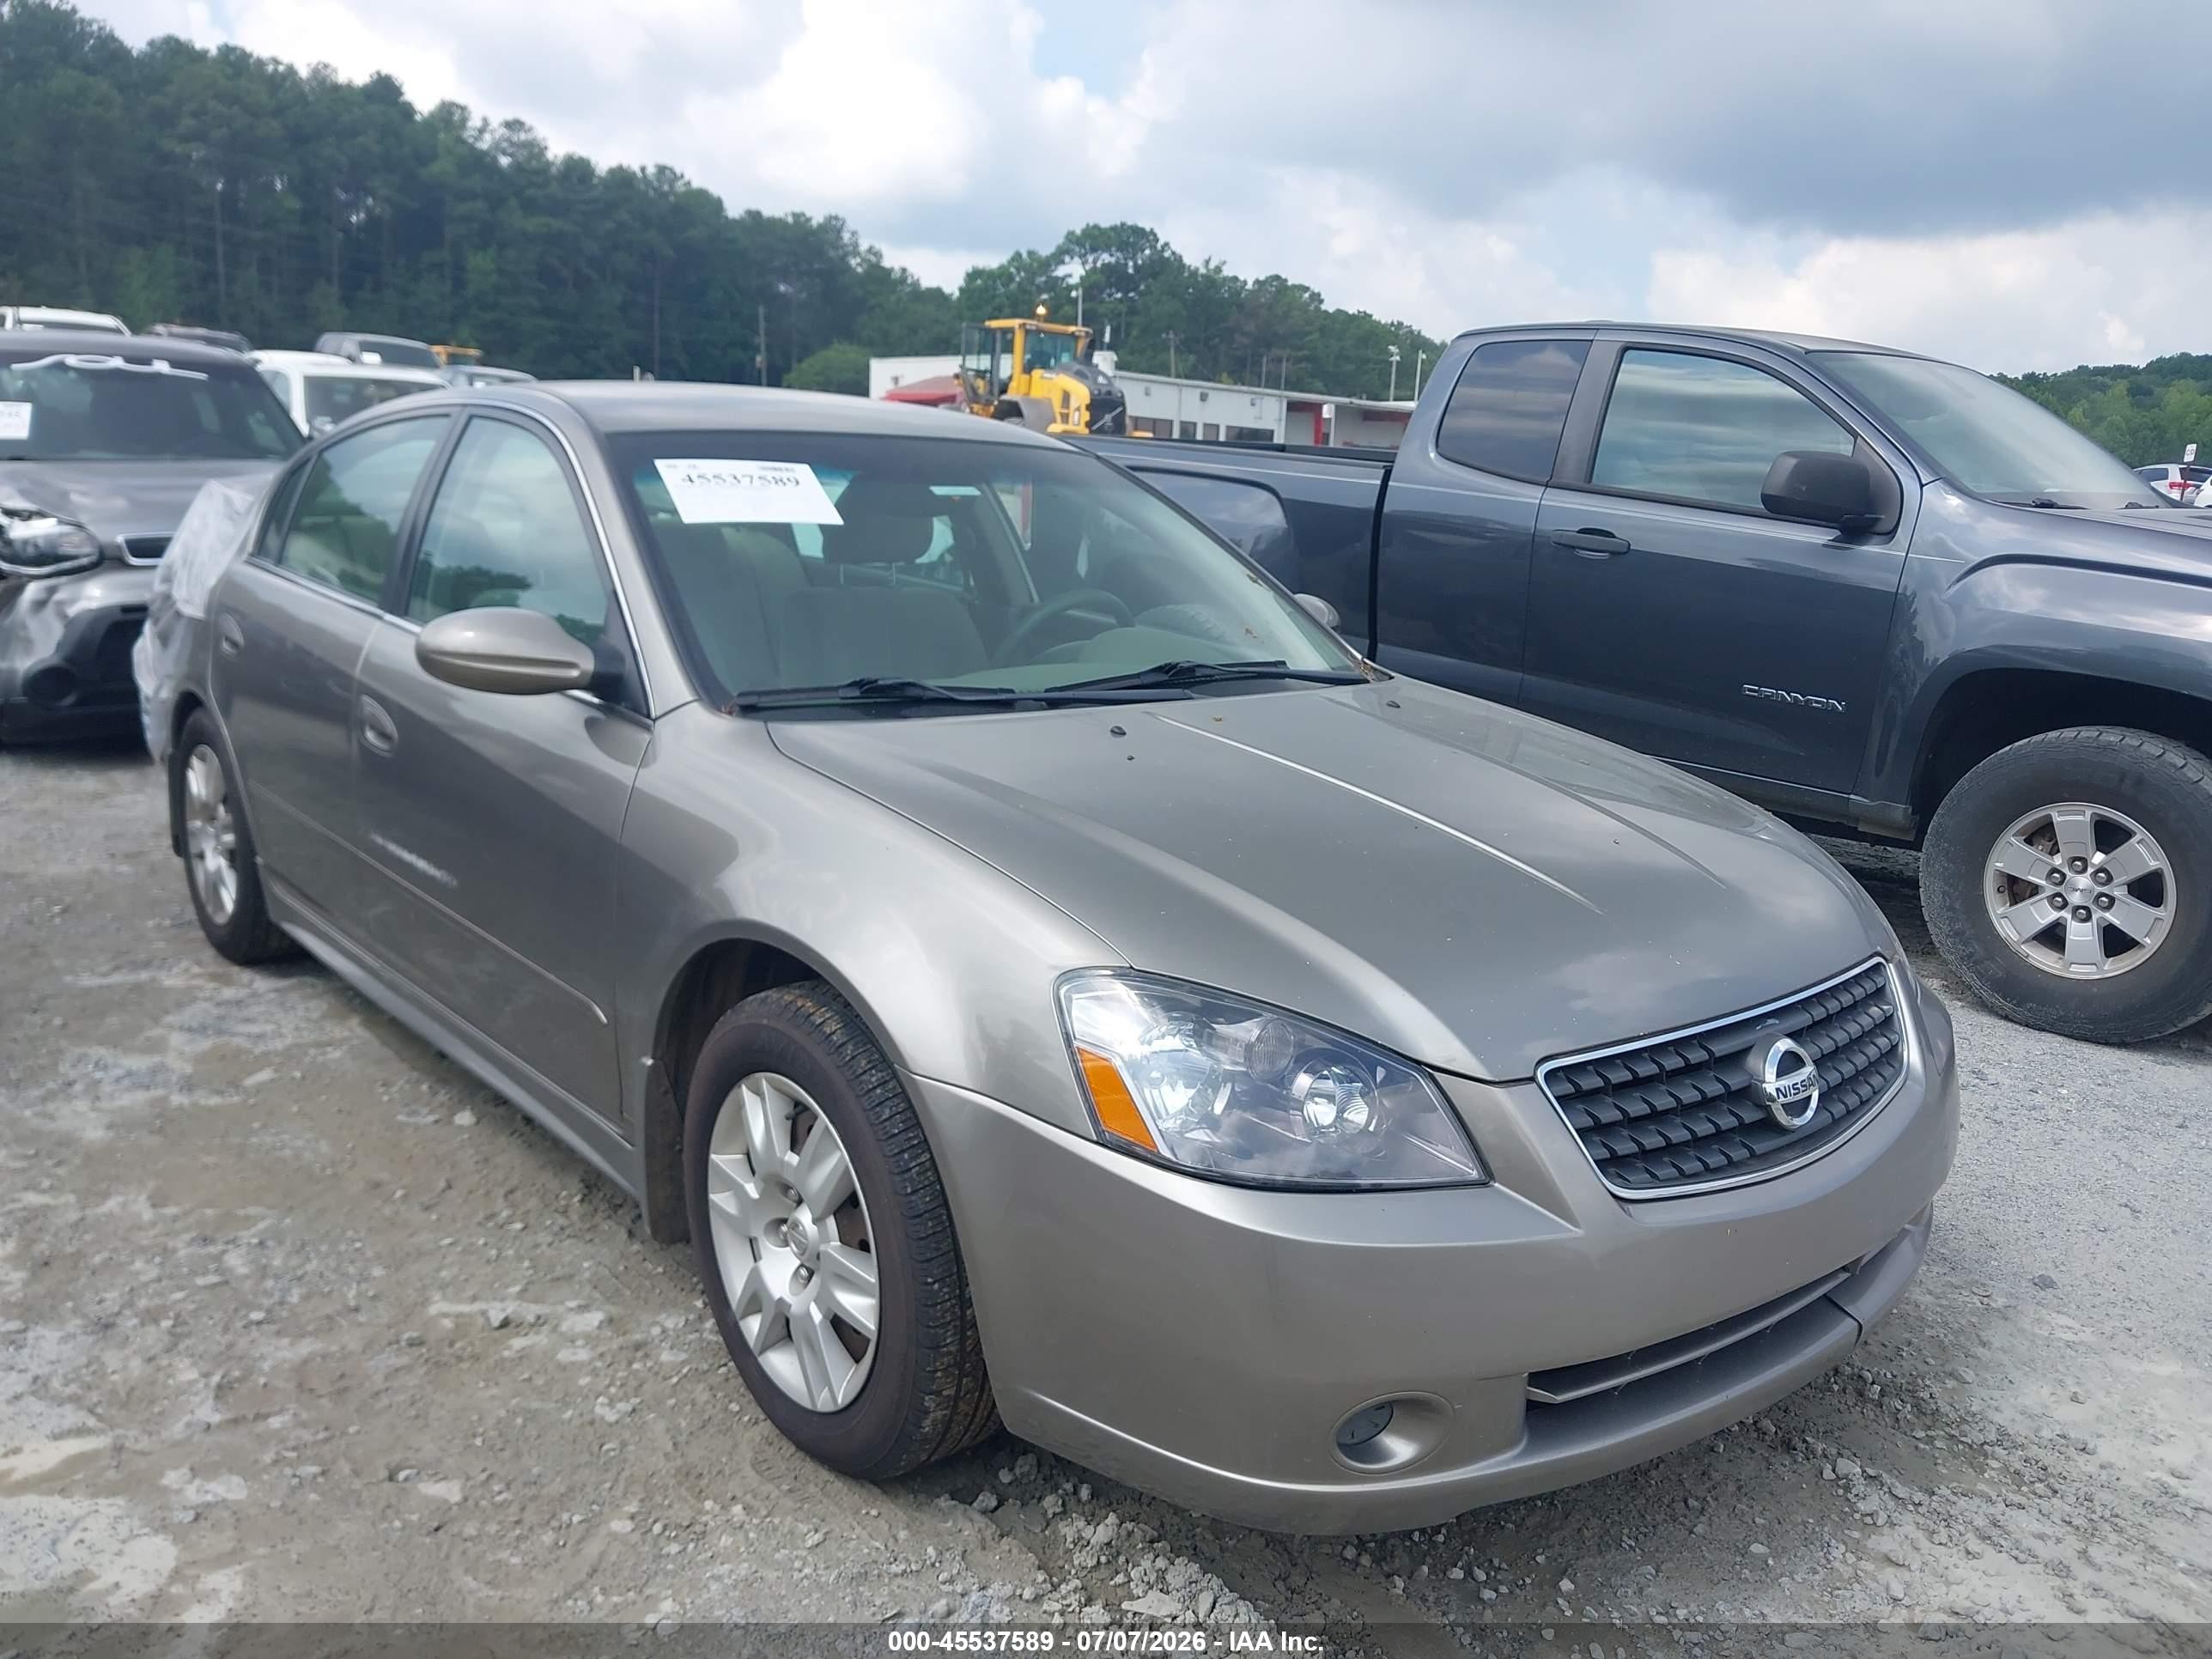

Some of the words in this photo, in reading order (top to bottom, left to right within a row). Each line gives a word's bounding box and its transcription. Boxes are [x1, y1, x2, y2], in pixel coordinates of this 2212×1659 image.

[682, 472, 800, 487] 45537589
[1742, 684, 1846, 712] CANYON
[1775, 1074, 1819, 1100] NISSAN
